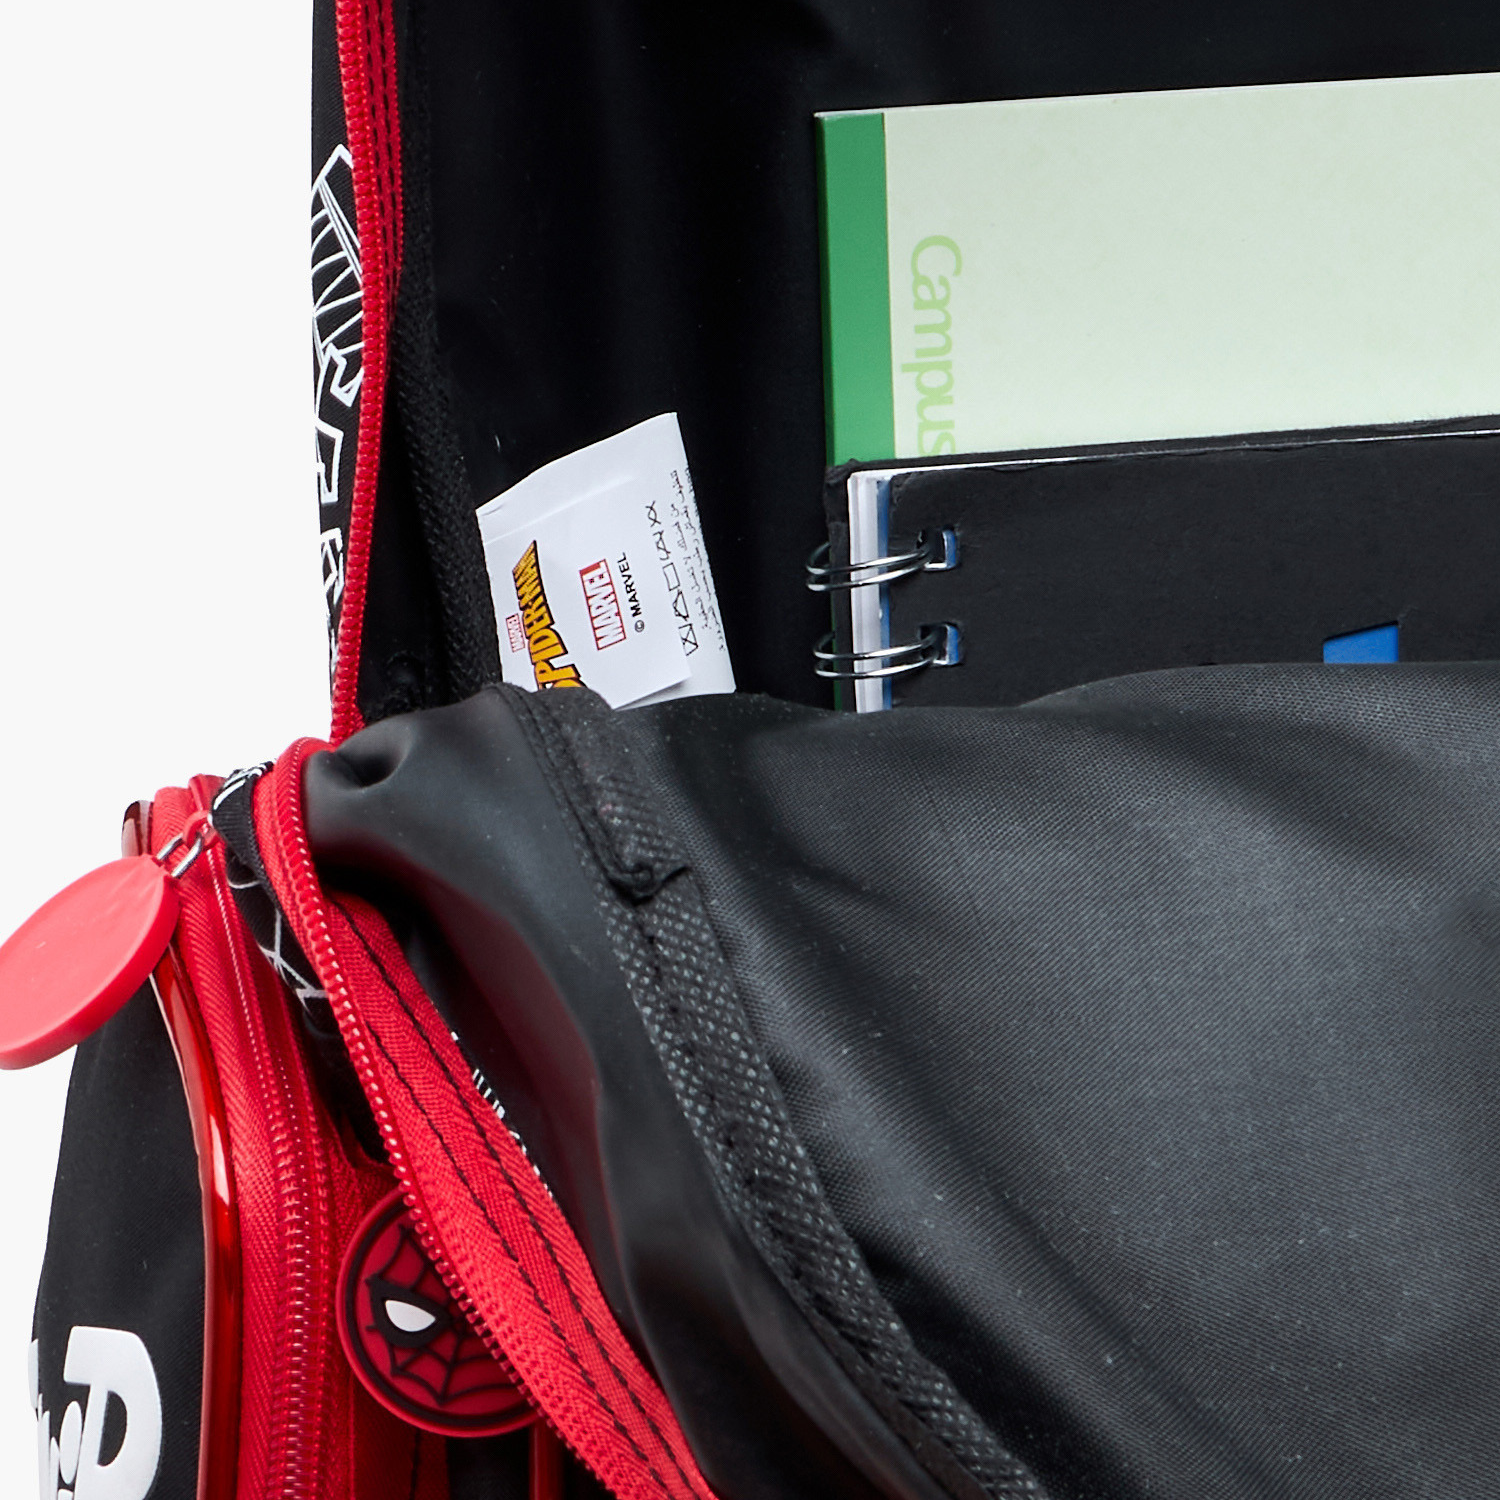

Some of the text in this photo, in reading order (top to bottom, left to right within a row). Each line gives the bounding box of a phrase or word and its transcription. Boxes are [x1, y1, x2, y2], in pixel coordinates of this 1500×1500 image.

[901, 235, 962, 456] Campus
[579, 560, 626, 650] MARVEL
[617, 552, 643, 618] MARVEL
